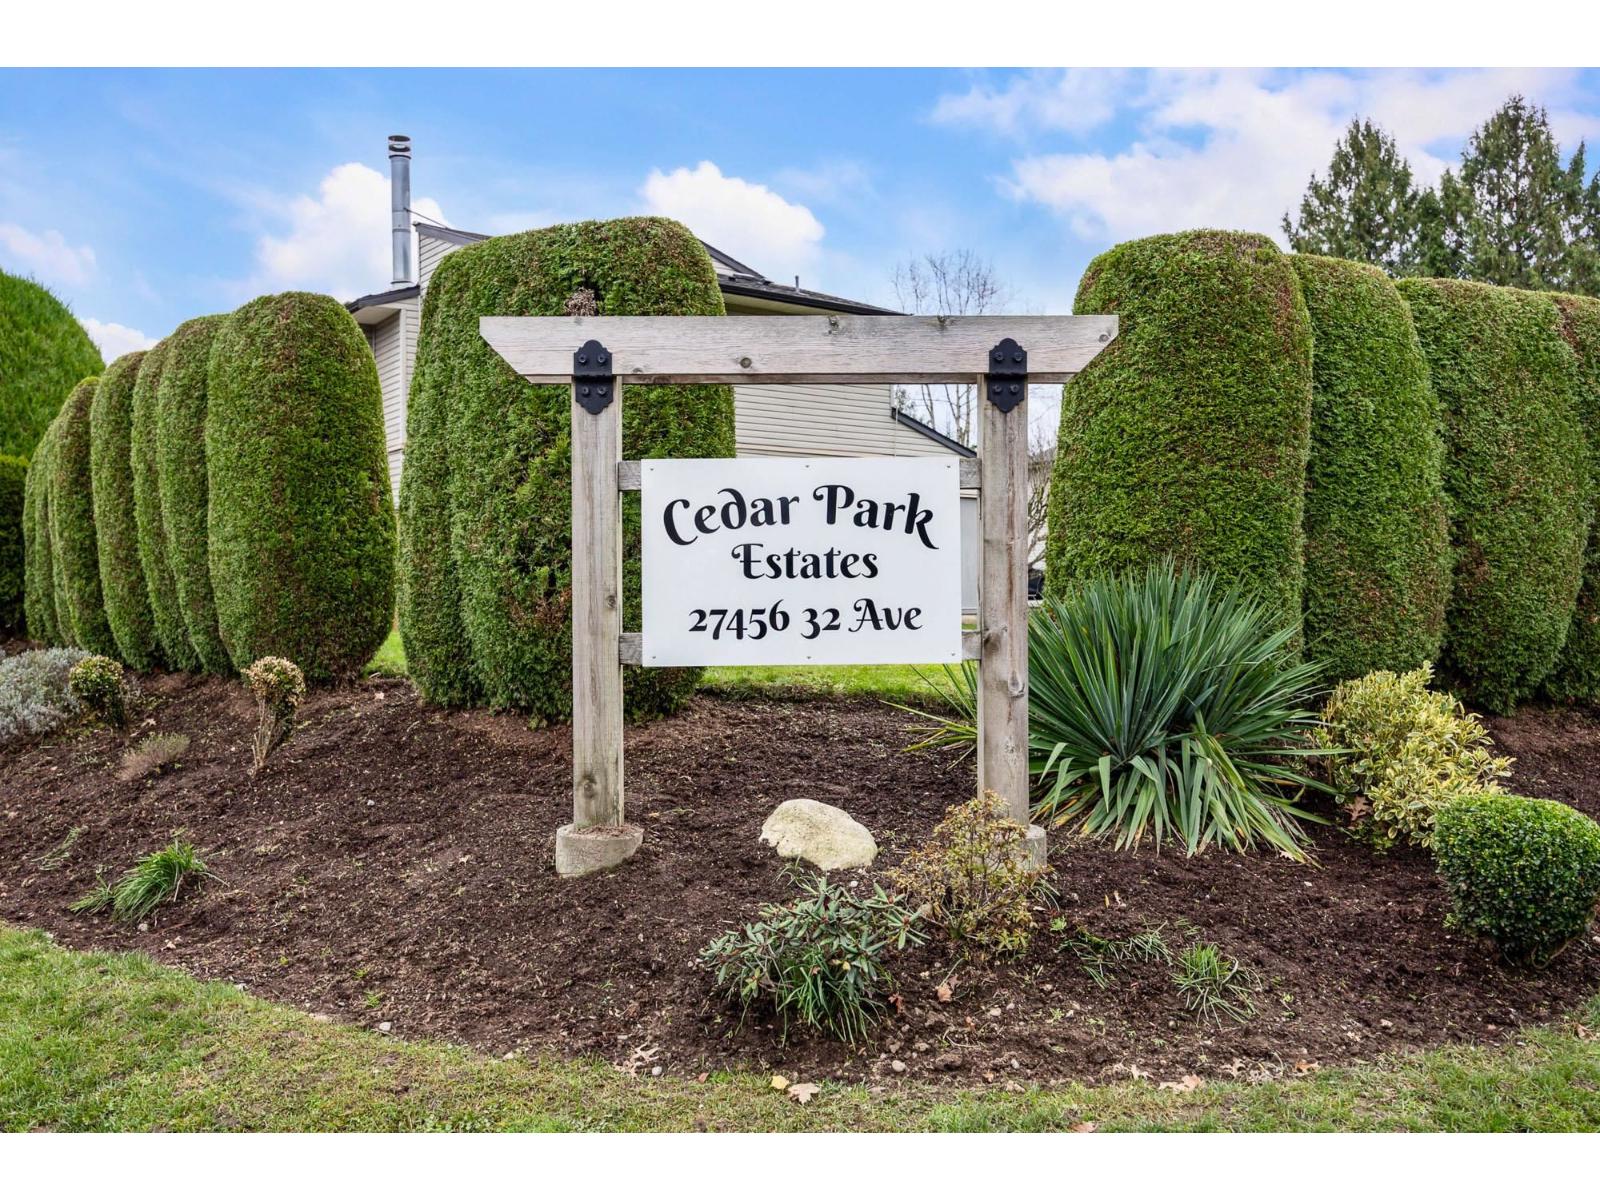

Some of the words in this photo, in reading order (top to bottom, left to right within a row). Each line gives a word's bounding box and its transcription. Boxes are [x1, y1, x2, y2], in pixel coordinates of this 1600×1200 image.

[663, 487, 800, 546] Cedar
[812, 484, 940, 550] Park
[731, 543, 879, 580] Estates
[688, 599, 790, 641] 27456
[800, 607, 841, 640] 32
[847, 598, 923, 633] Ave
